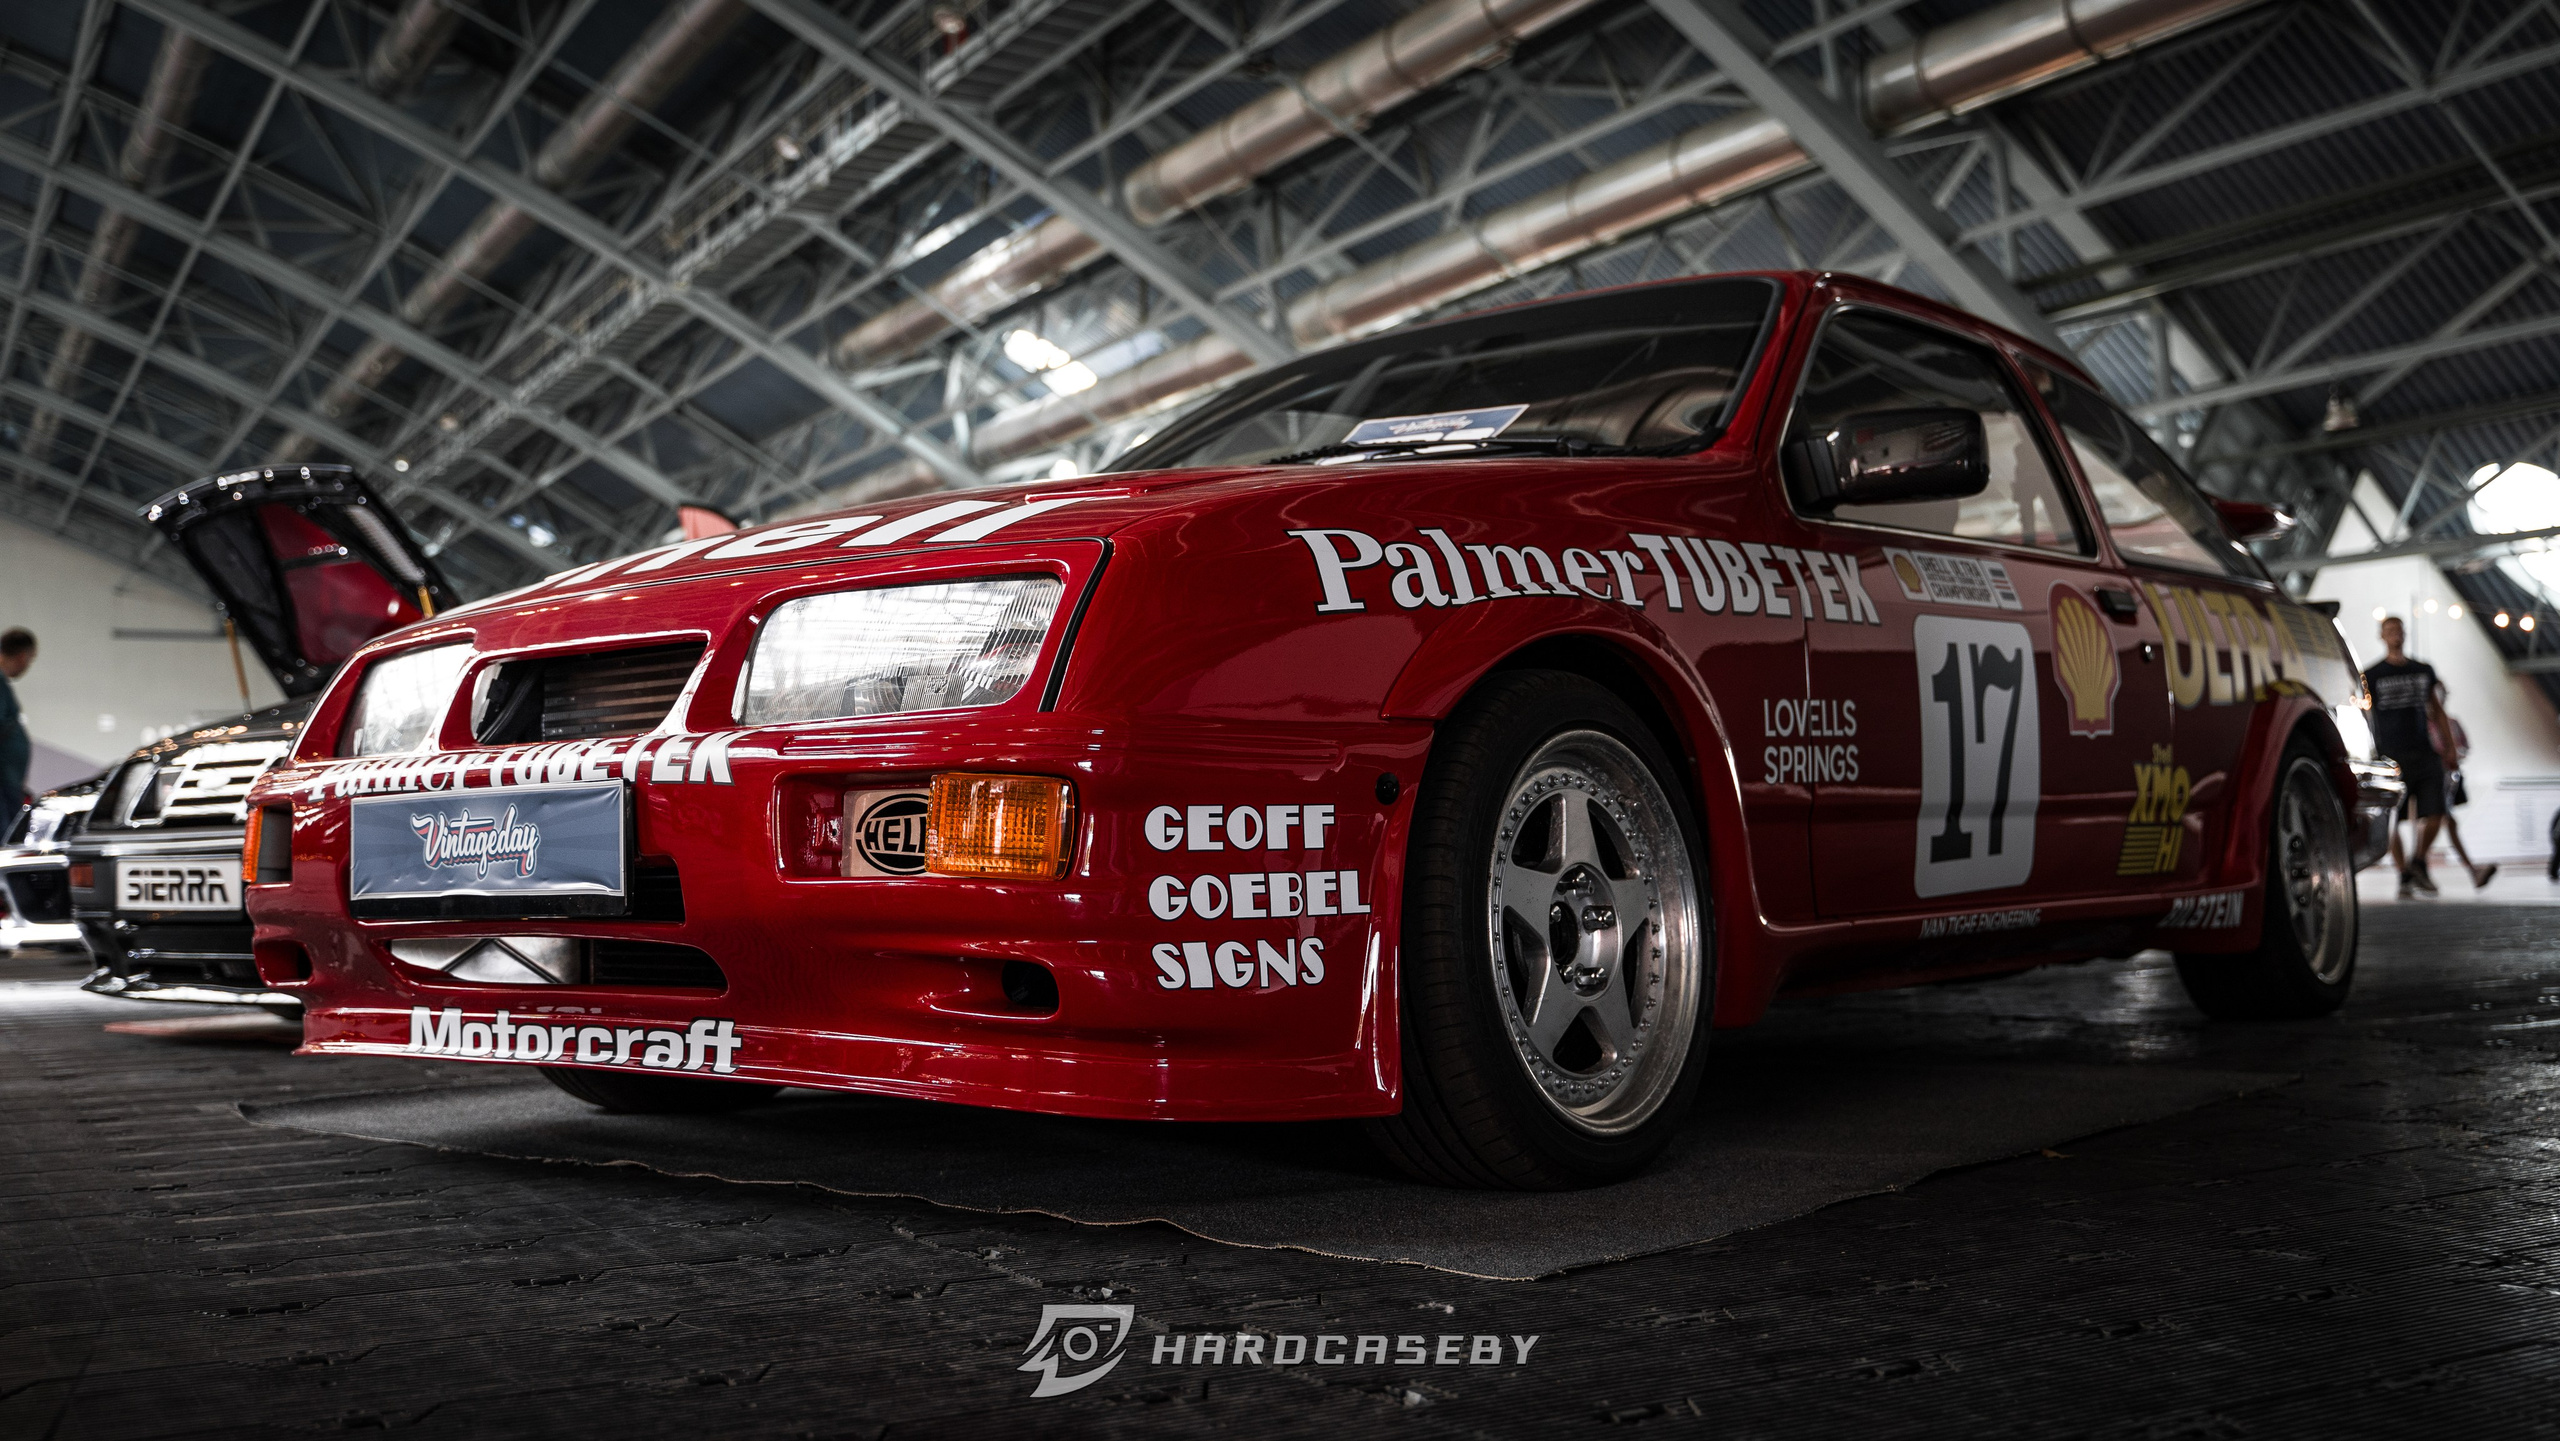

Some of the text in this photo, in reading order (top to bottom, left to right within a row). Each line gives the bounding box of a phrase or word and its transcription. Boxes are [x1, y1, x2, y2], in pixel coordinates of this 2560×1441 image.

[1763, 698, 1857, 737] LOVELLS
[1763, 744, 1859, 784] SPRINGS
[1930, 642, 2023, 864] 17
[2129, 762, 2190, 824] XMO
[411, 804, 539, 880] Vintageday
[1144, 804, 1335, 851] GEOFF
[127, 868, 229, 902] SIERRA
[1148, 869, 1371, 921] GOEBEL
[1151, 936, 1325, 990] SIGNS
[406, 1005, 742, 1074] Motorcraft
